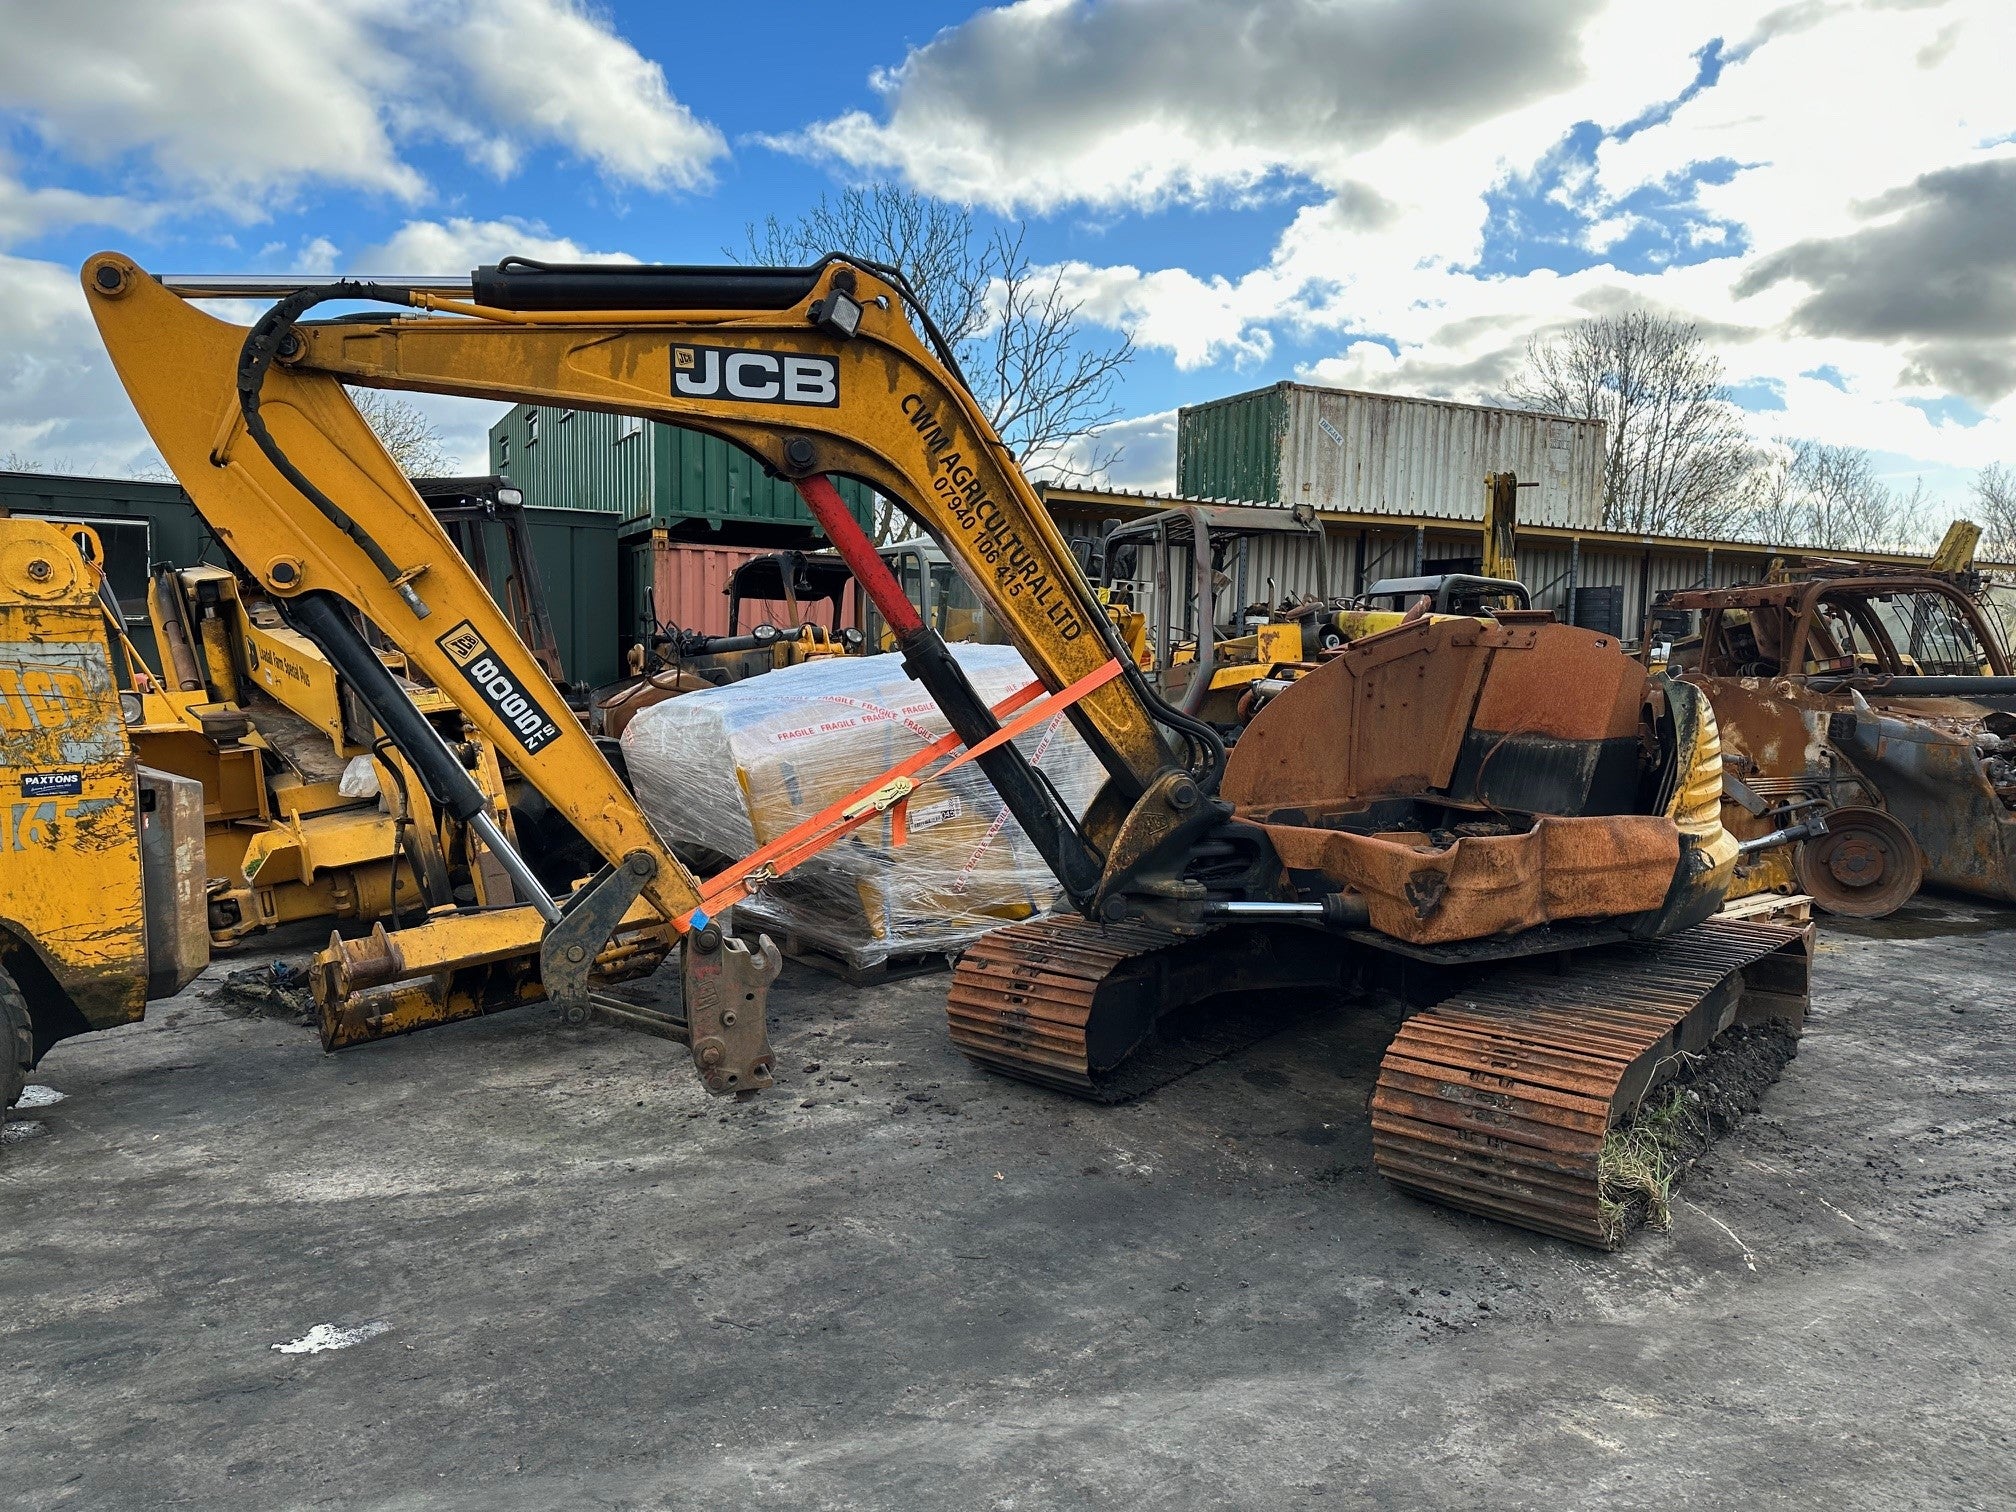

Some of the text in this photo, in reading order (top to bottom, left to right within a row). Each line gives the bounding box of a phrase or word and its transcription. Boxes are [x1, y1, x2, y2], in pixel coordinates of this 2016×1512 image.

[675, 350, 836, 403] JCB
[677, 351, 693, 364] JCB
[901, 393, 1082, 642] CWM AGRICULTURAL LTD
[933, 476, 1024, 597] 07940 106 415
[450, 635, 477, 656] JCB
[470, 657, 543, 735] 8065
[777, 727, 815, 741] FRAGILE
[820, 718, 856, 732] FRAGILE
[901, 702, 935, 715] FRAGILE
[861, 702, 898, 720] FRAGILE
[903, 718, 933, 741] FRAGILE
[25, 774, 78, 785] PAXTONS
[965, 842, 988, 873] FRAGILE
